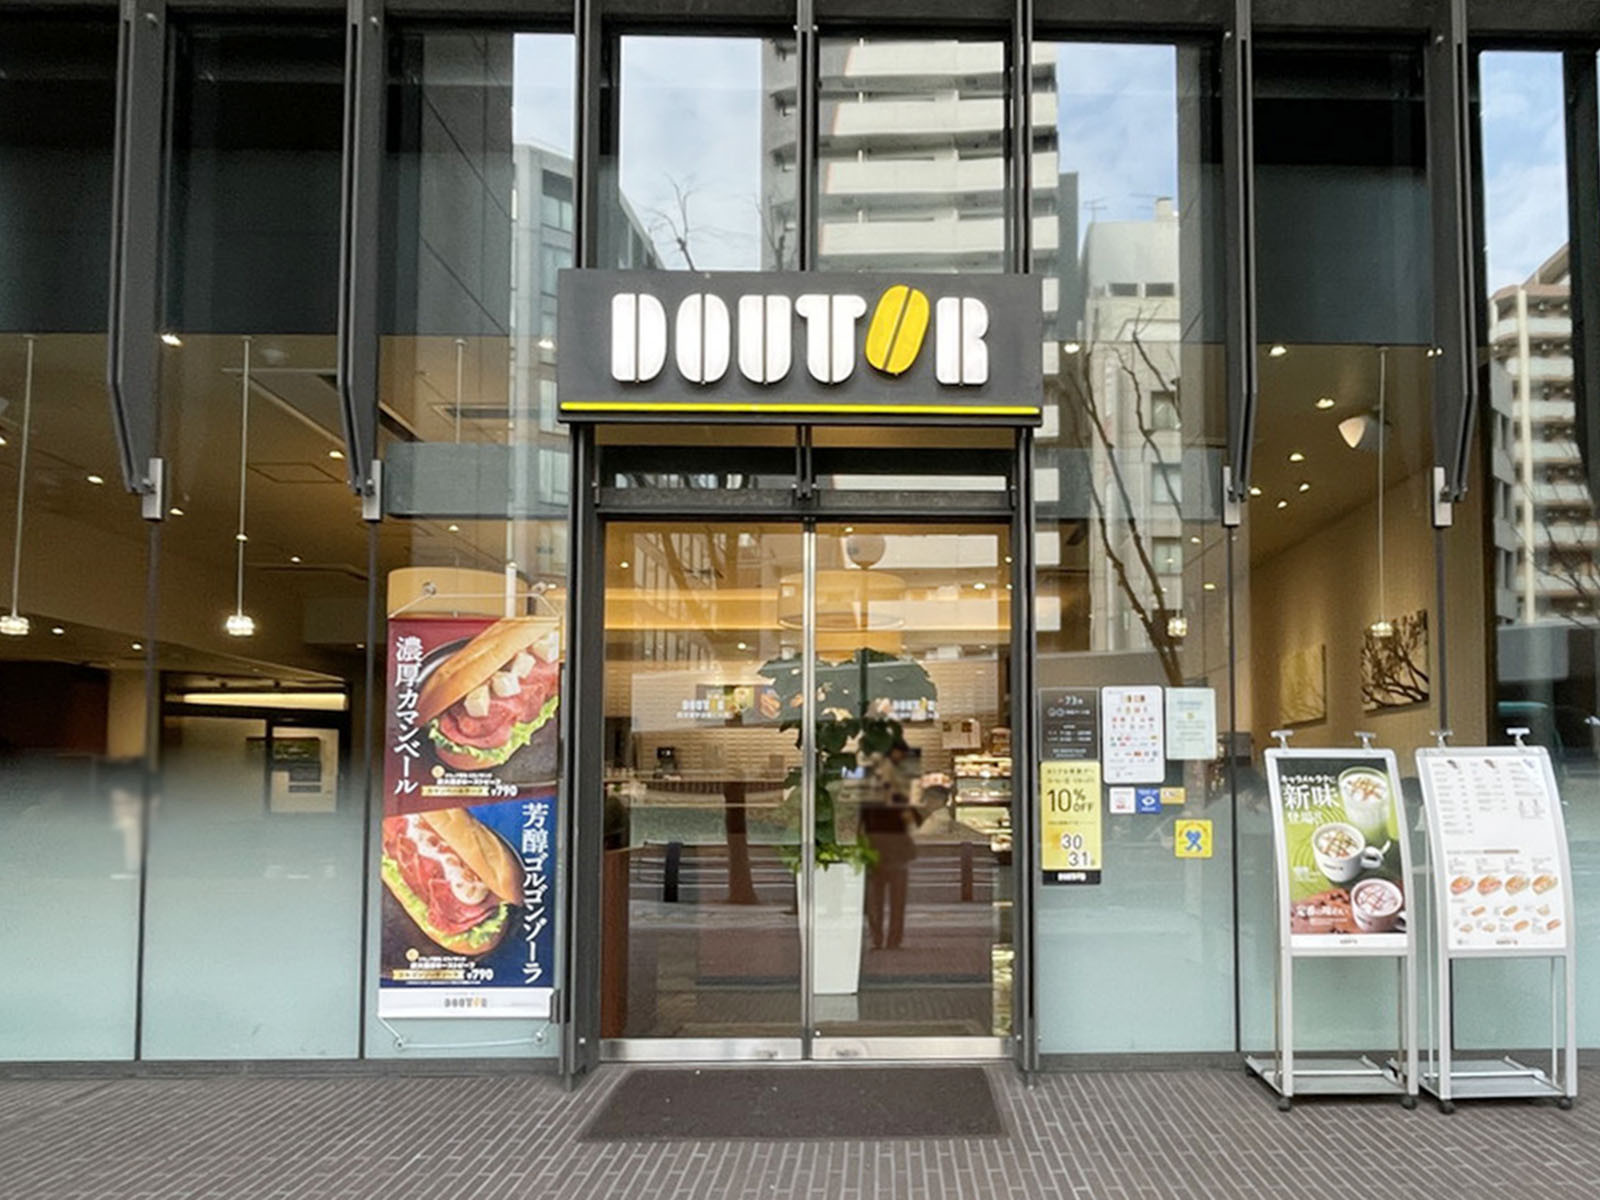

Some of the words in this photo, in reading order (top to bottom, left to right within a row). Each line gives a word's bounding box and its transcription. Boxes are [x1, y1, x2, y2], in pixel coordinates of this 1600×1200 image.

[611, 285, 989, 385] DOUTOR
[393, 636, 423, 795] 濃厚カマンベール
[1283, 783, 1341, 811] 新味
[522, 803, 549, 984] 芳醇ゴルゴンゾーラ
